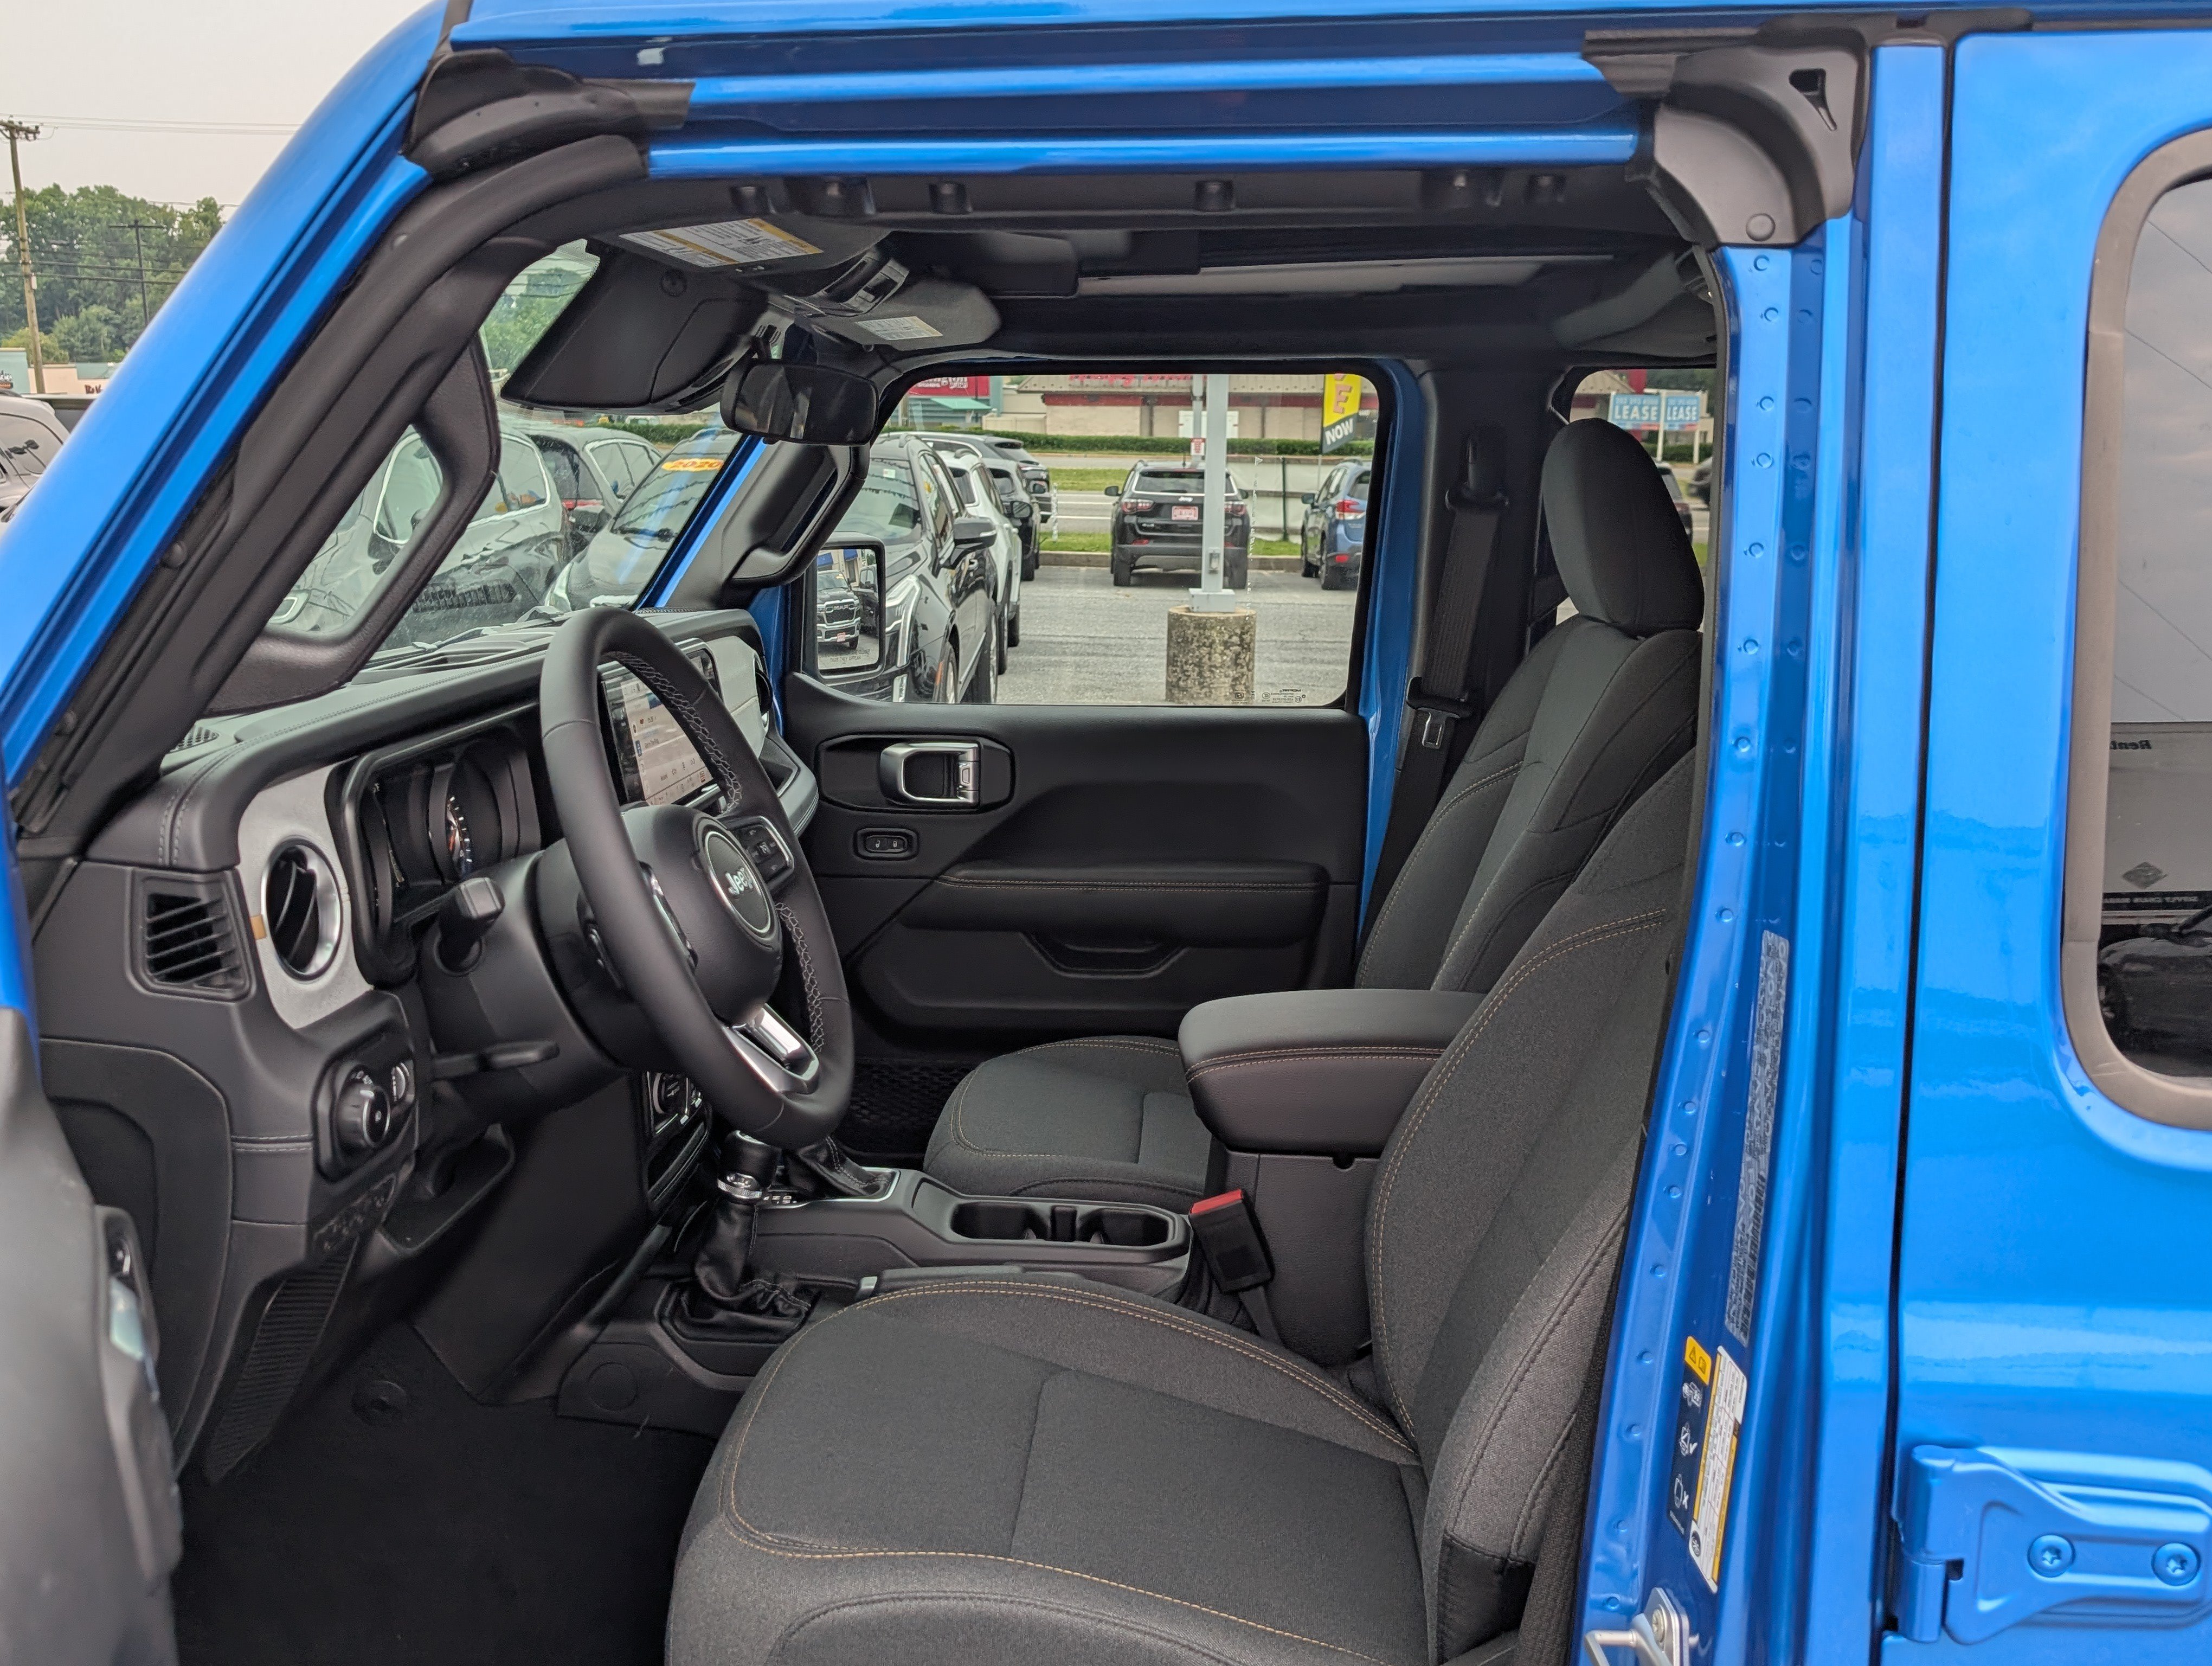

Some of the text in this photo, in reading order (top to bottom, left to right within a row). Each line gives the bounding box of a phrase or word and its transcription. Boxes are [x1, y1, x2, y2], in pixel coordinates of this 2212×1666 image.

[1614, 405, 1658, 421] LEASE
[1666, 406, 1697, 421] LEASE
[1324, 418, 1354, 445] NOW
[669, 460, 723, 469] 2020
[725, 867, 754, 895] Jeep
